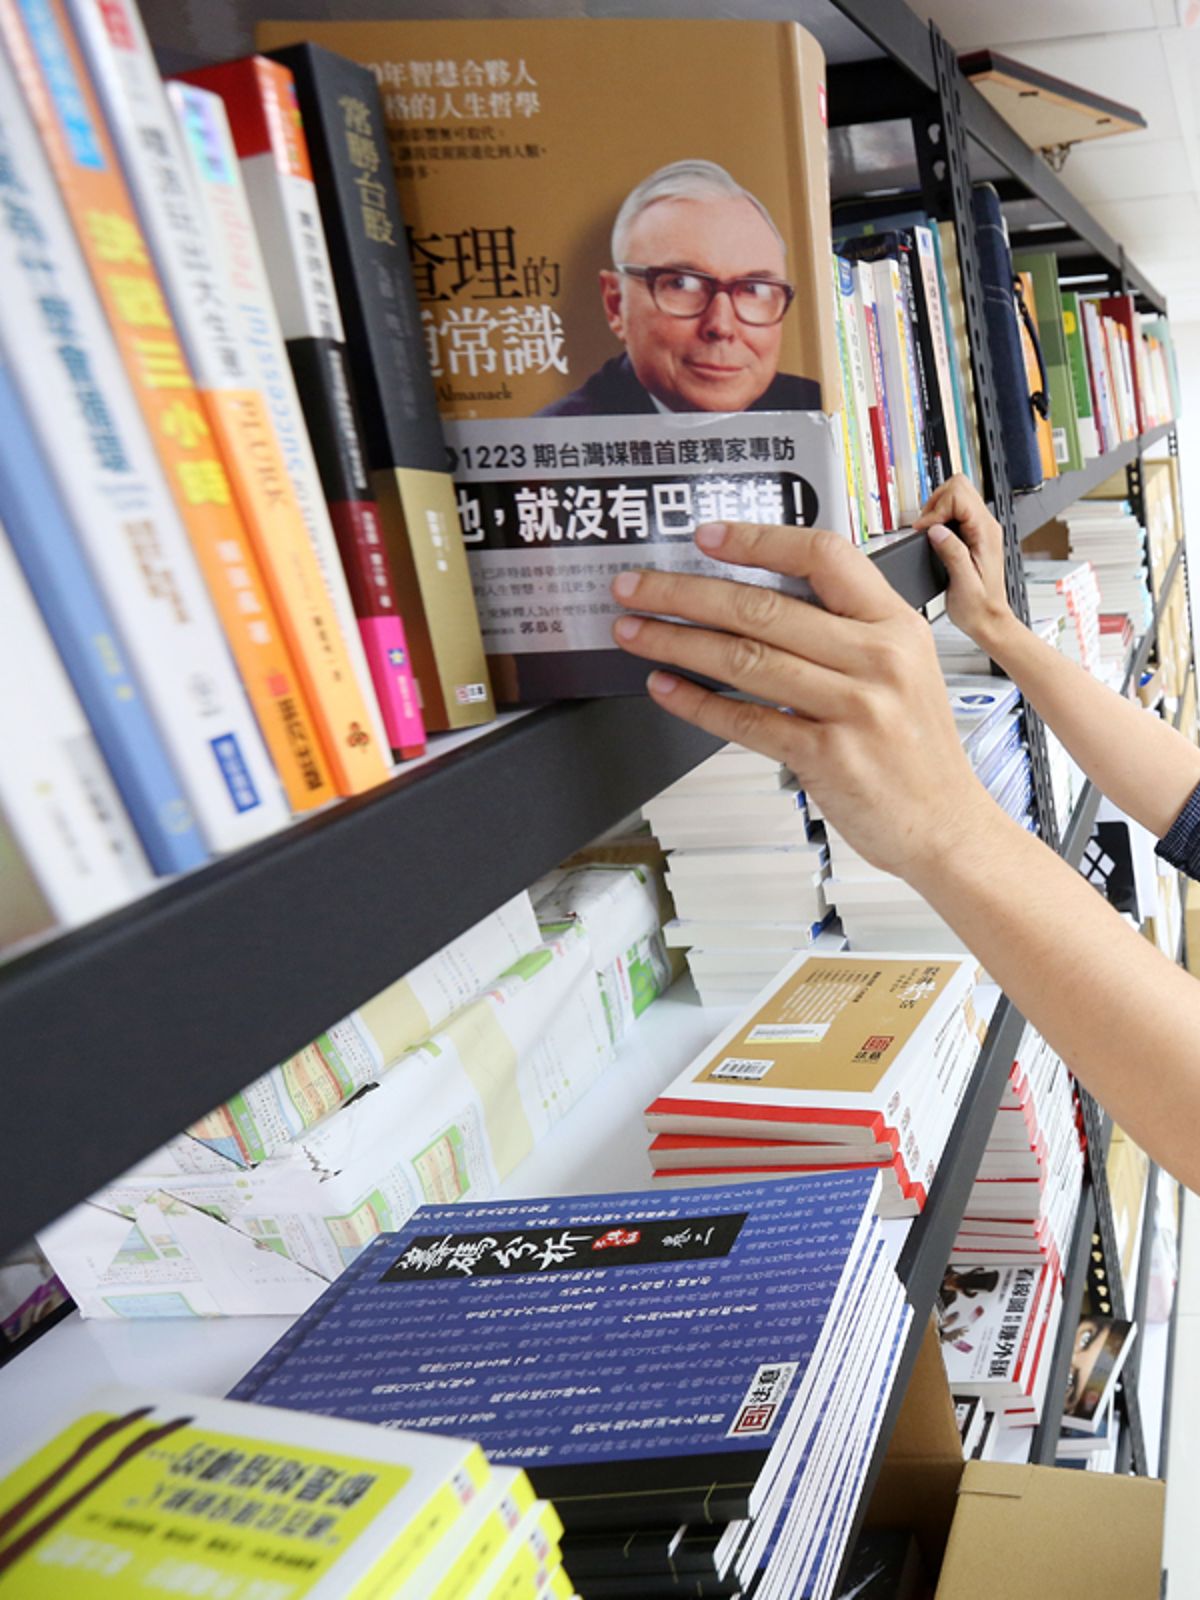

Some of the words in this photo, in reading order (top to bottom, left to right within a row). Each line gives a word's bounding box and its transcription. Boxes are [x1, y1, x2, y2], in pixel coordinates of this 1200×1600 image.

[462, 444, 528, 470] 1223
[532, 436, 796, 469] 期台灣媒體首度獨家專訪
